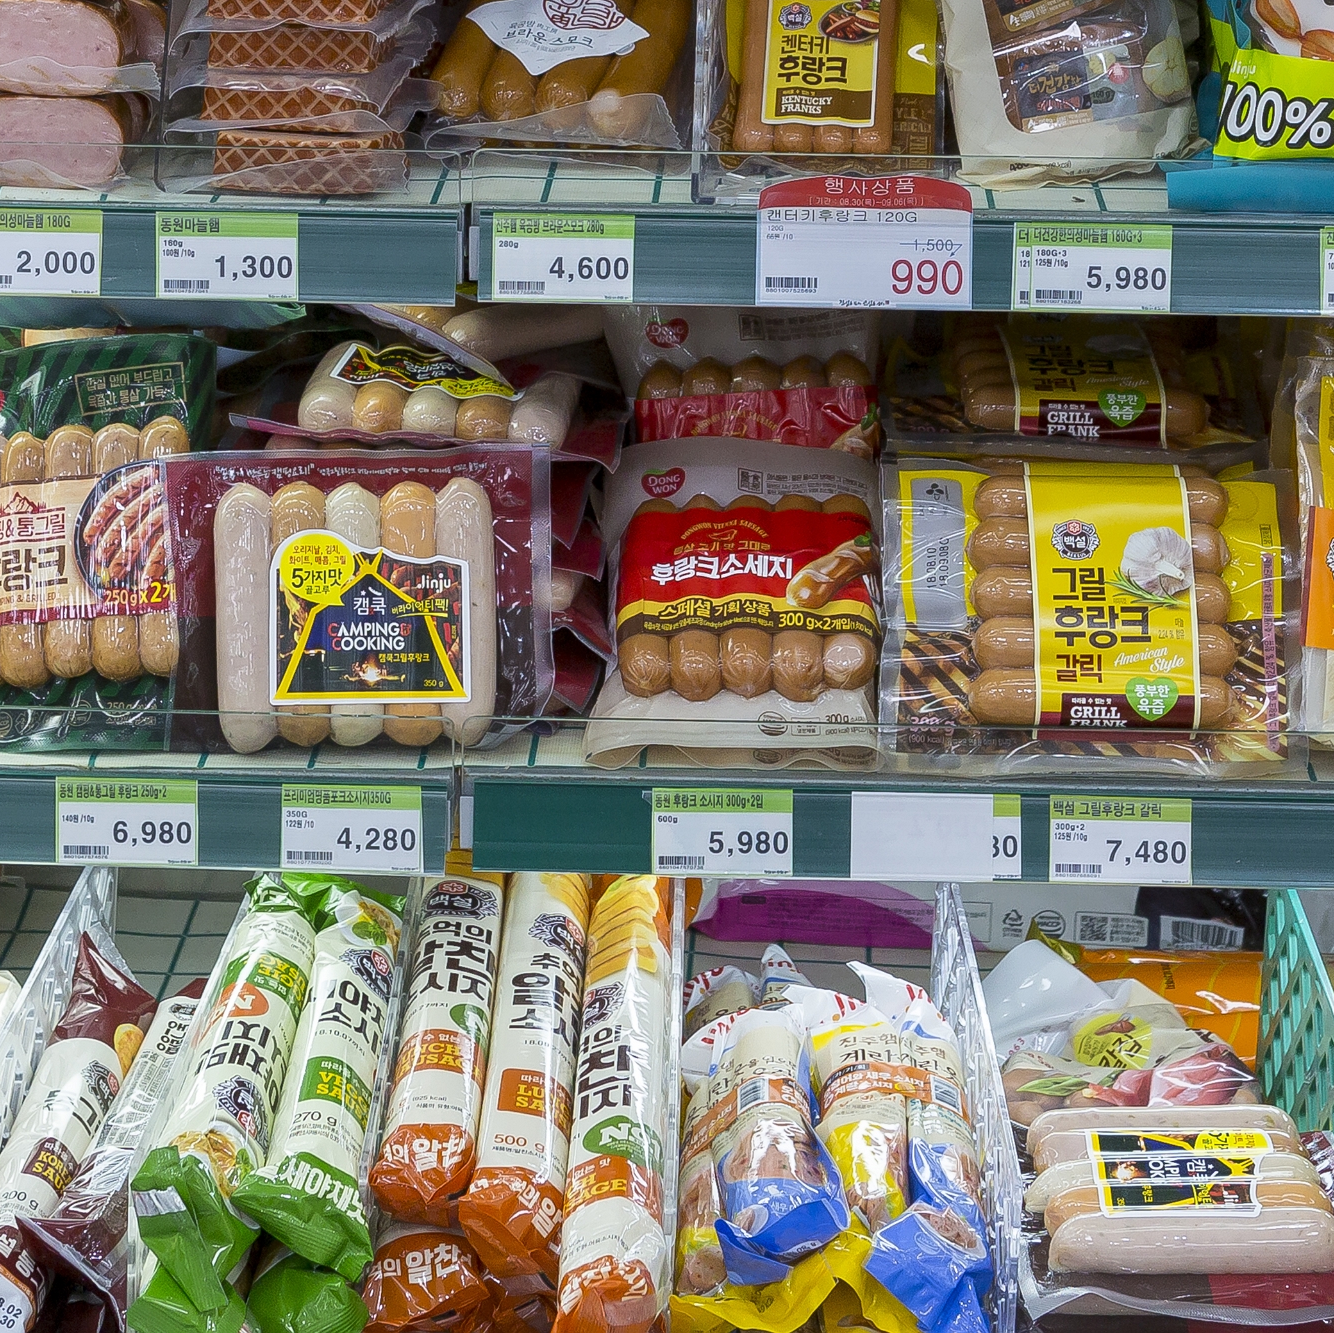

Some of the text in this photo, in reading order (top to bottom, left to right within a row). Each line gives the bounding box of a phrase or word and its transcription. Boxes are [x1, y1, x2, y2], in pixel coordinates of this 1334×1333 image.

[780, 33, 830, 54] 켄터키
[776, 55, 848, 85] 후랑크
[781, 94, 833, 106] KENTUCKY
[781, 104, 823, 114] FRANKS
[825, 178, 915, 195] 행사상품
[160, 218, 219, 233] 동원마늘햄
[913, 239, 953, 252] 1,500
[17, 251, 95, 276] 2,000
[216, 256, 292, 281] 1,300
[550, 257, 628, 282] 4,600
[892, 260, 962, 295] 990
[1087, 266, 1166, 292] 5,980
[650, 555, 793, 585] 후랑크소세지
[1051, 565, 1106, 603] 그릴
[658, 598, 772, 623] 스페셜 기획 상품
[1053, 604, 1150, 648] 후랑크
[1055, 652, 1105, 684] 갈릭
[655, 793, 723, 810] 동원 후랑크 소시지
[1053, 801, 1162, 818] 백설 그릴후랑크 갈릭
[114, 821, 191, 846] 6,980
[337, 828, 415, 853] 4,280
[709, 831, 788, 857] 5,980
[1107, 840, 1186, 865] 7,480
